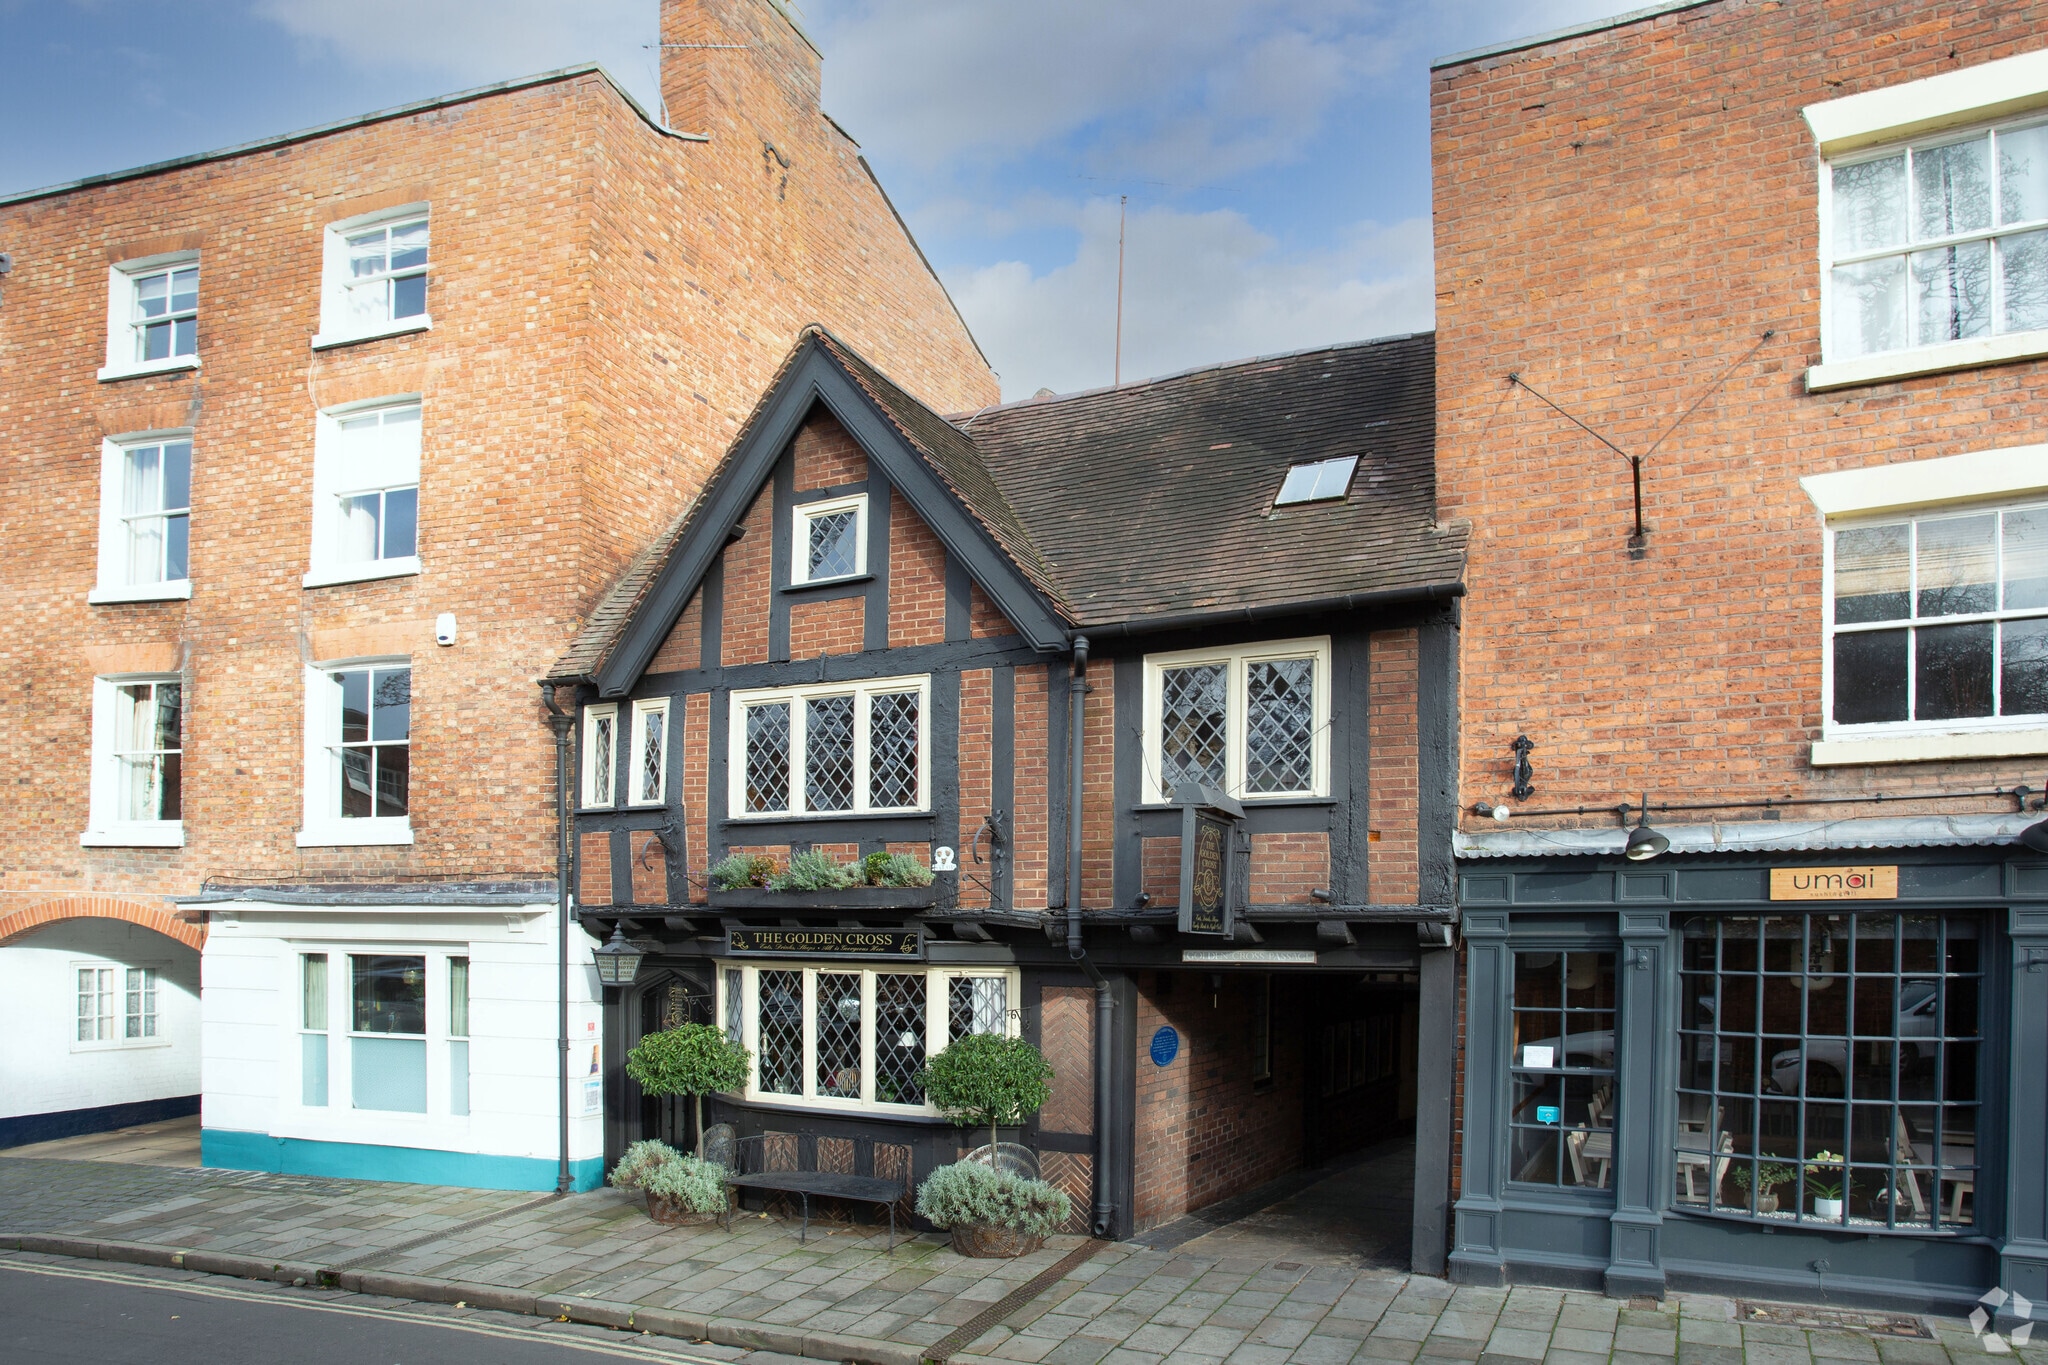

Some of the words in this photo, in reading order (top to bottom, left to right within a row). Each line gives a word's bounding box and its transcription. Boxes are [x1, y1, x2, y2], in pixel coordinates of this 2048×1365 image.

[1205, 840, 1215, 850] THE
[1200, 849, 1219, 860] GOLDEN
[1202, 859, 1217, 869] CROSS
[1793, 868, 1874, 889] umai
[753, 932, 782, 943] THE
[785, 933, 842, 944] GOLDEN
[846, 933, 893, 945] CROSS
[1186, 951, 1230, 960] GOLDEN
[1231, 951, 1265, 960] CROSS
[1268, 951, 1311, 961] PASSAGE
